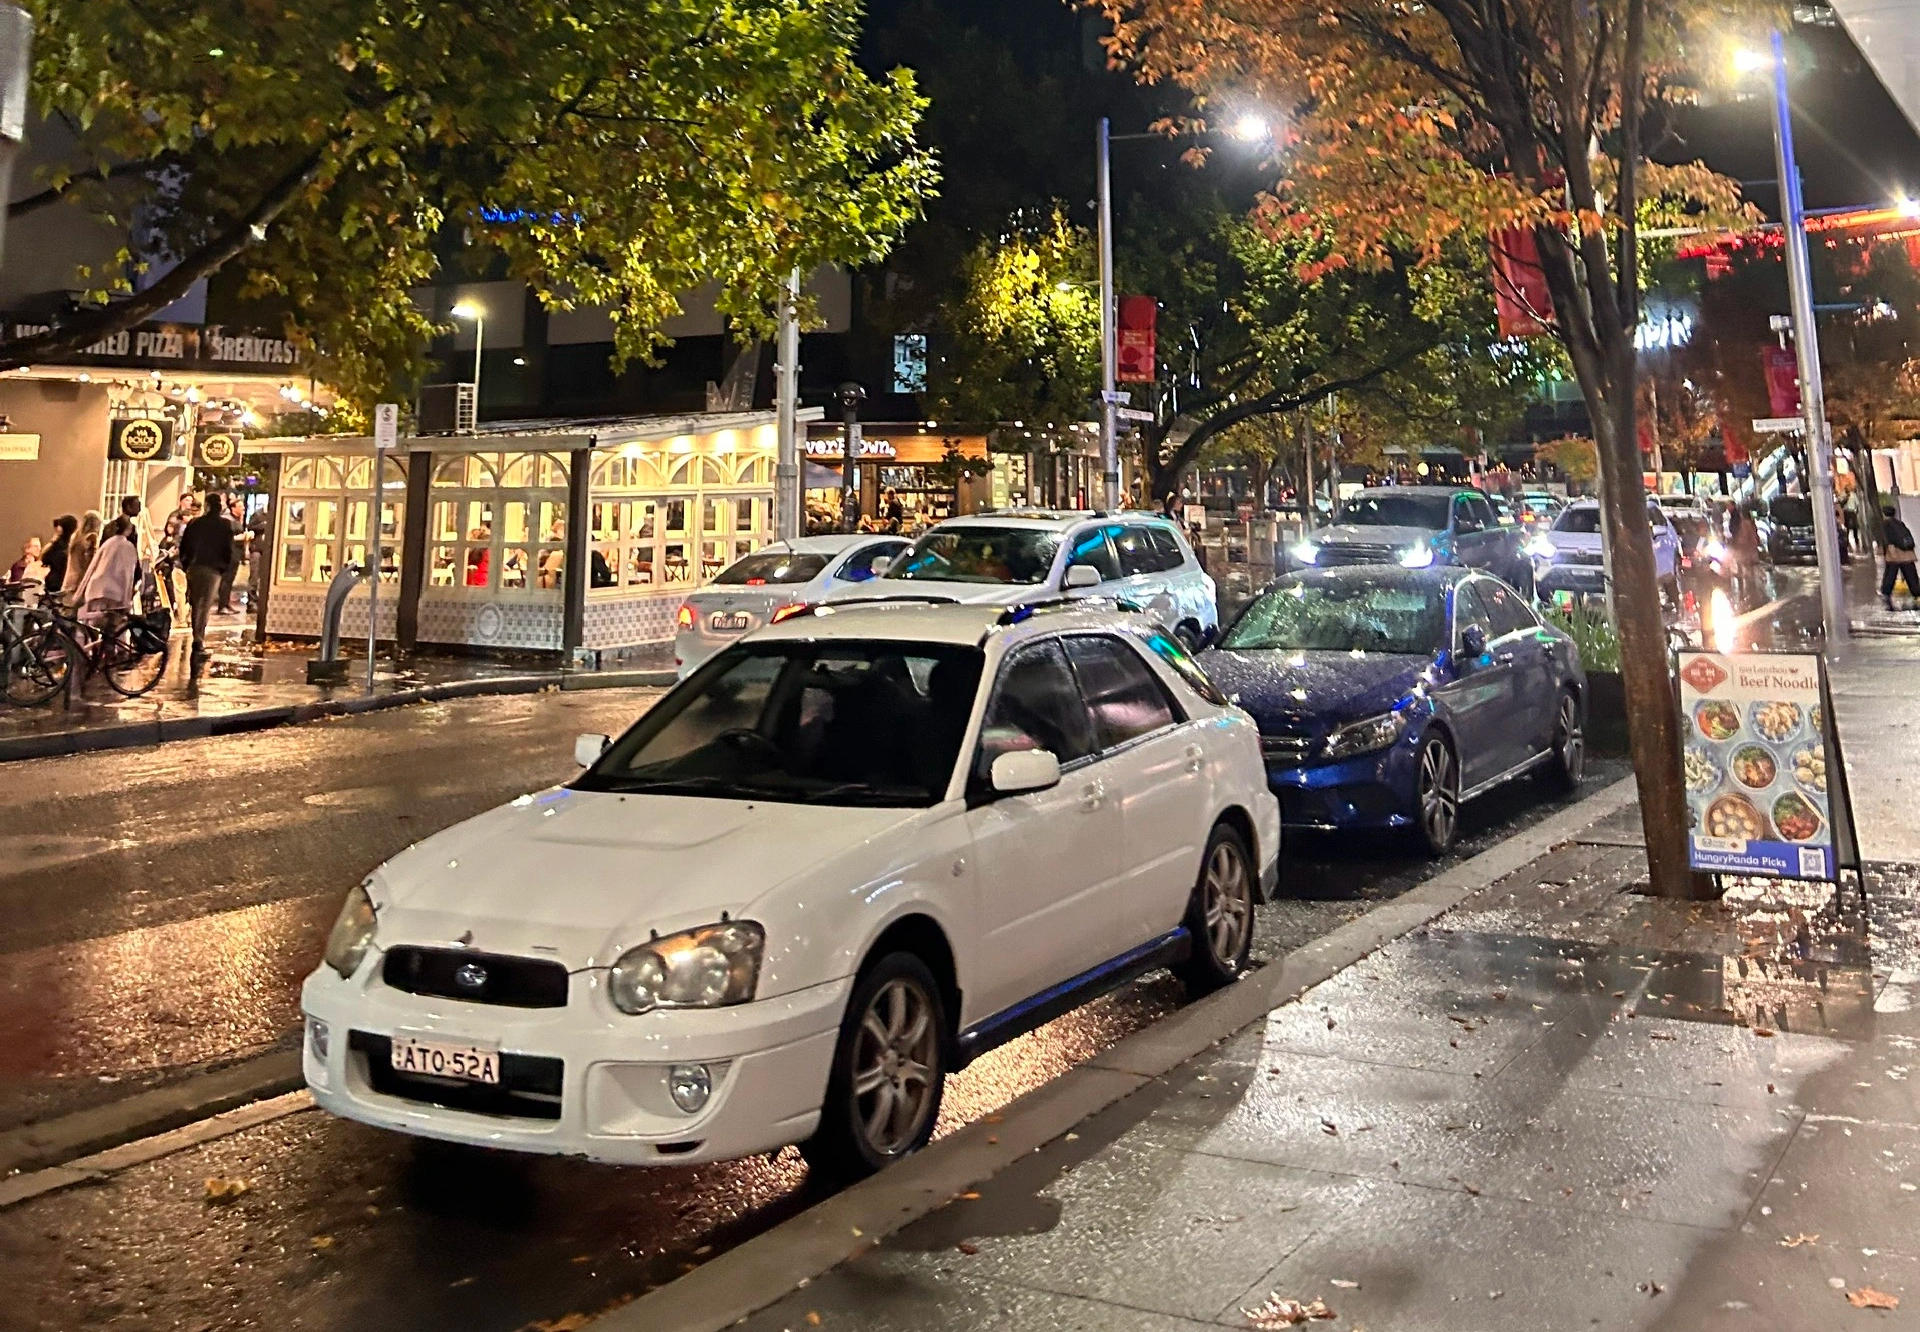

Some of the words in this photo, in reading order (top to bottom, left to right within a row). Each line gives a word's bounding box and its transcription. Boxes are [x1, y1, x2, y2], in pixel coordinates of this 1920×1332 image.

[136, 331, 184, 359] PIZZA
[1740, 675, 1770, 688] Beef
[1694, 851, 1759, 867] HungryPanda
[1762, 856, 1787, 868] Picks
